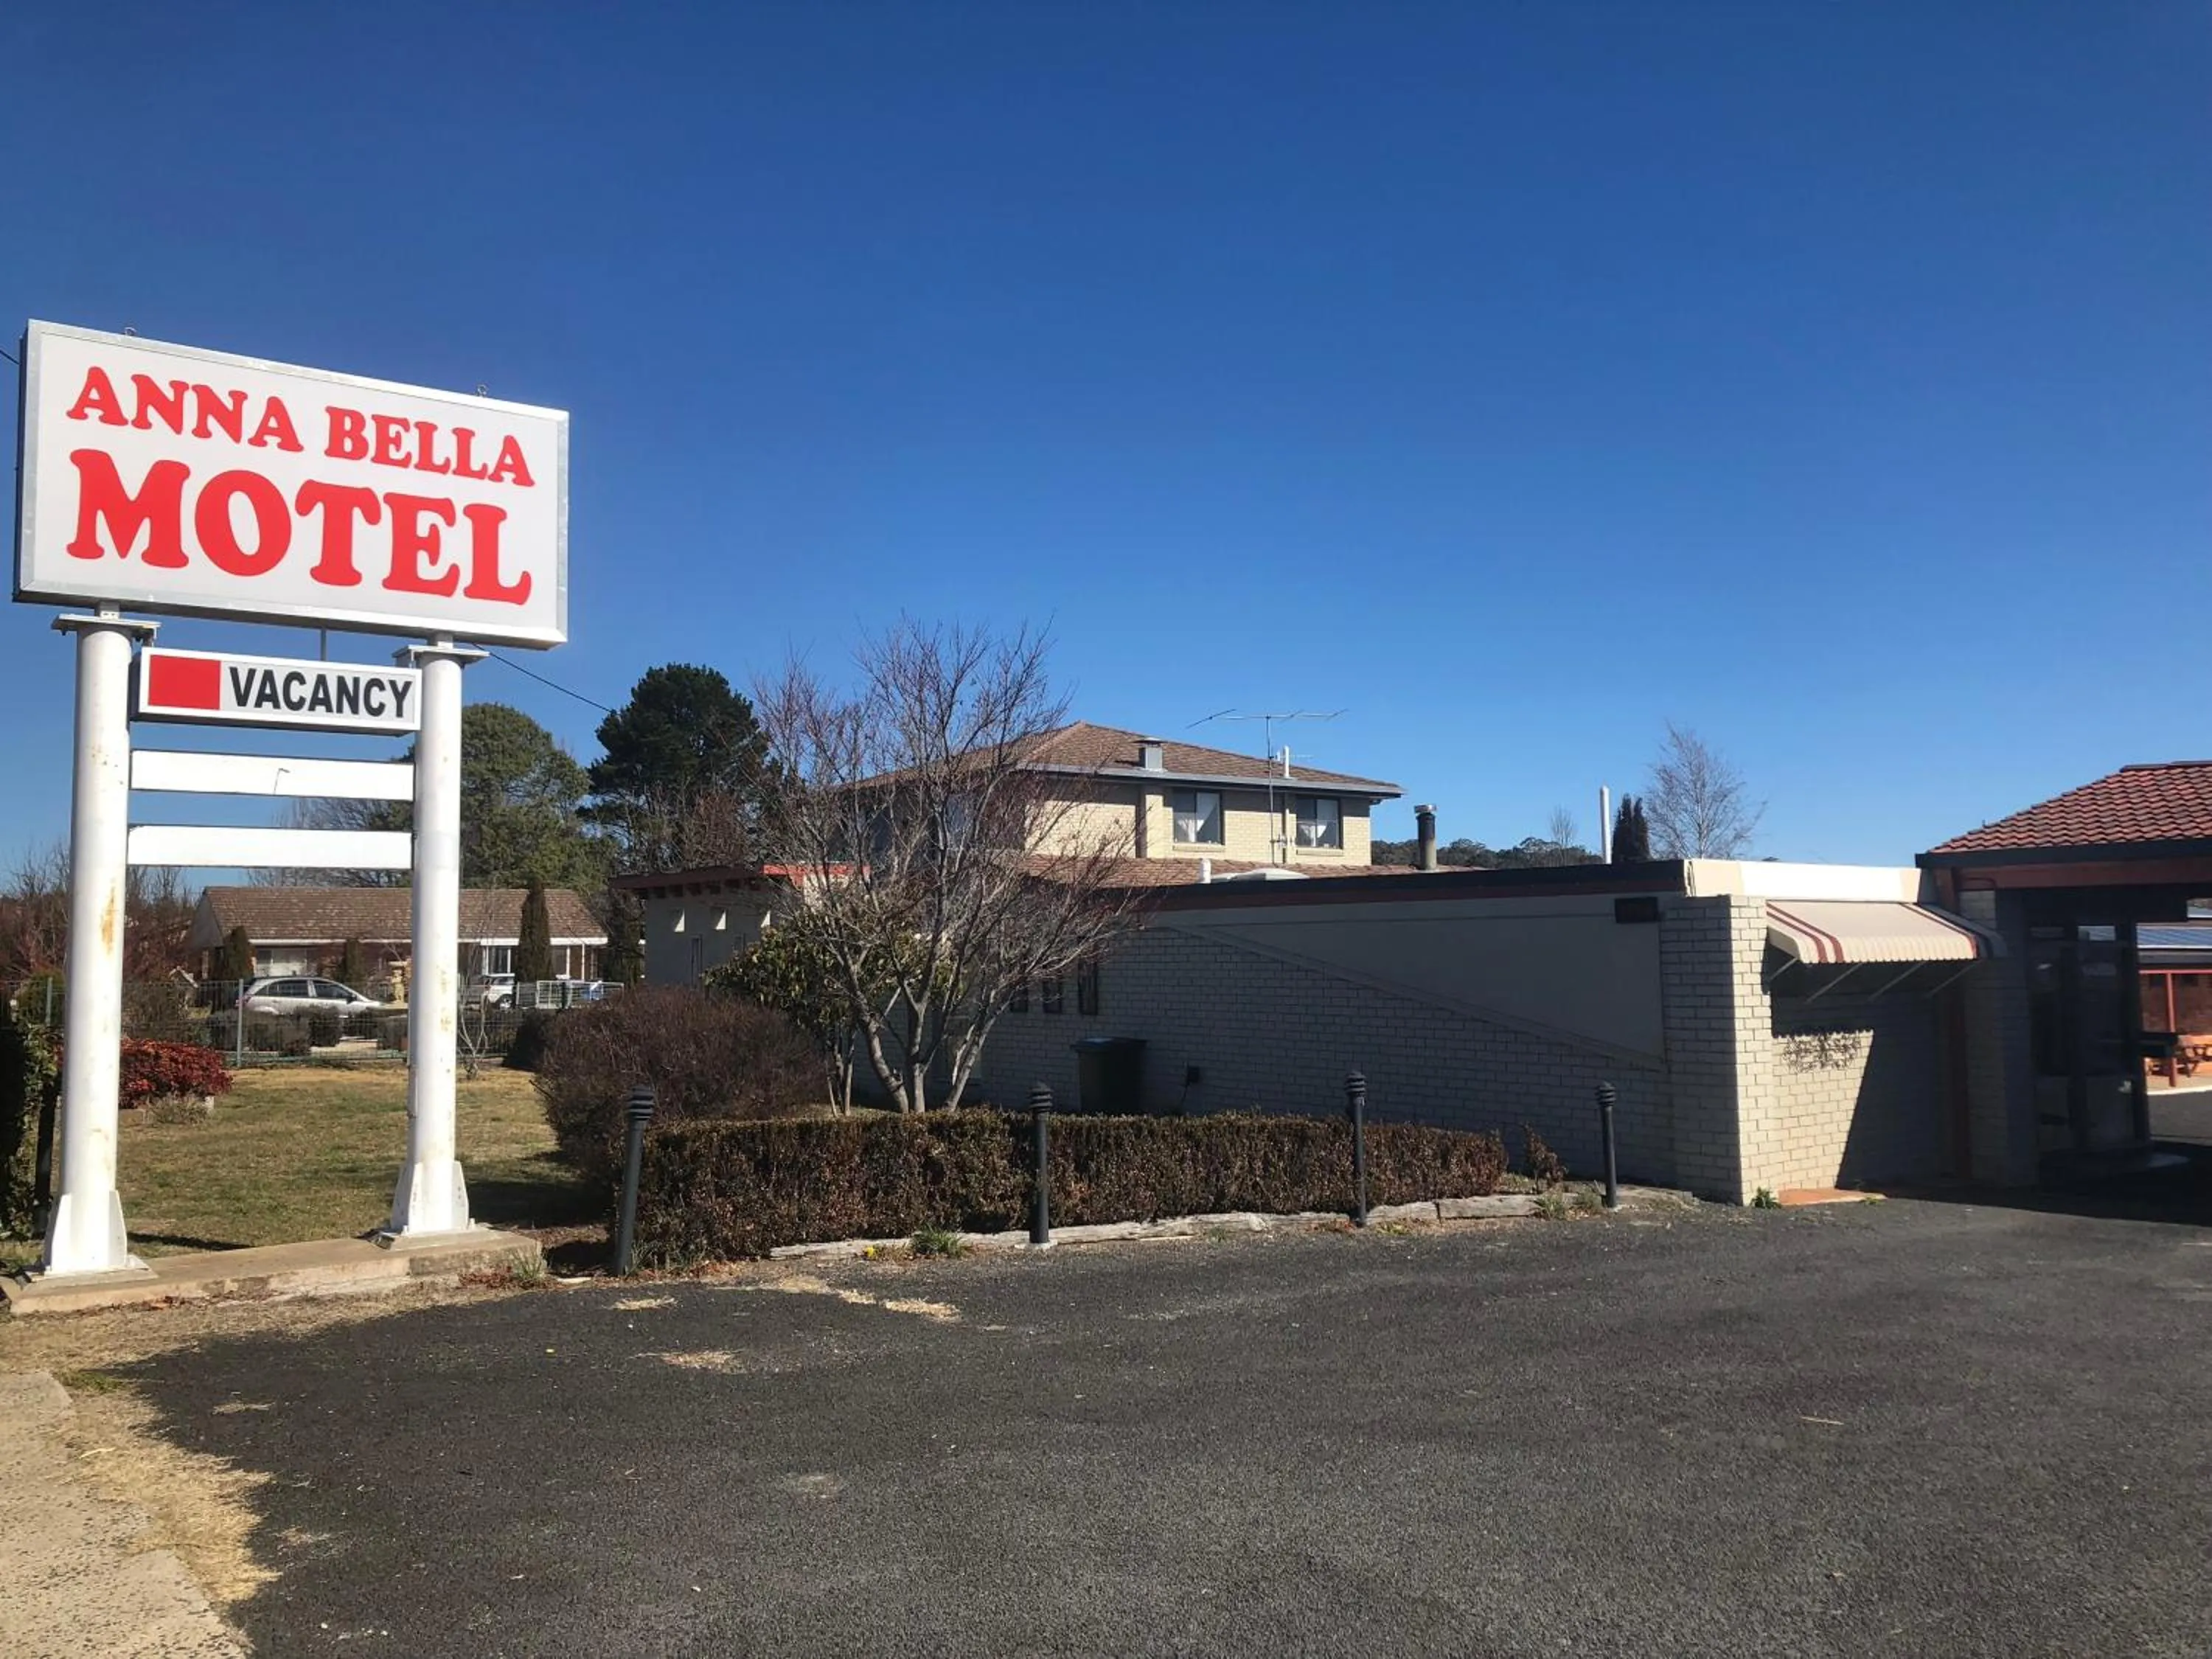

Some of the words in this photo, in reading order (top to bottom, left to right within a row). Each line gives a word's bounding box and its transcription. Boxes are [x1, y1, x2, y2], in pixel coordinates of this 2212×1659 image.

[67, 366, 304, 452] ANNA
[324, 406, 535, 487] BELLA
[66, 449, 532, 605] MOTEL
[229, 667, 413, 718] VACANCY
